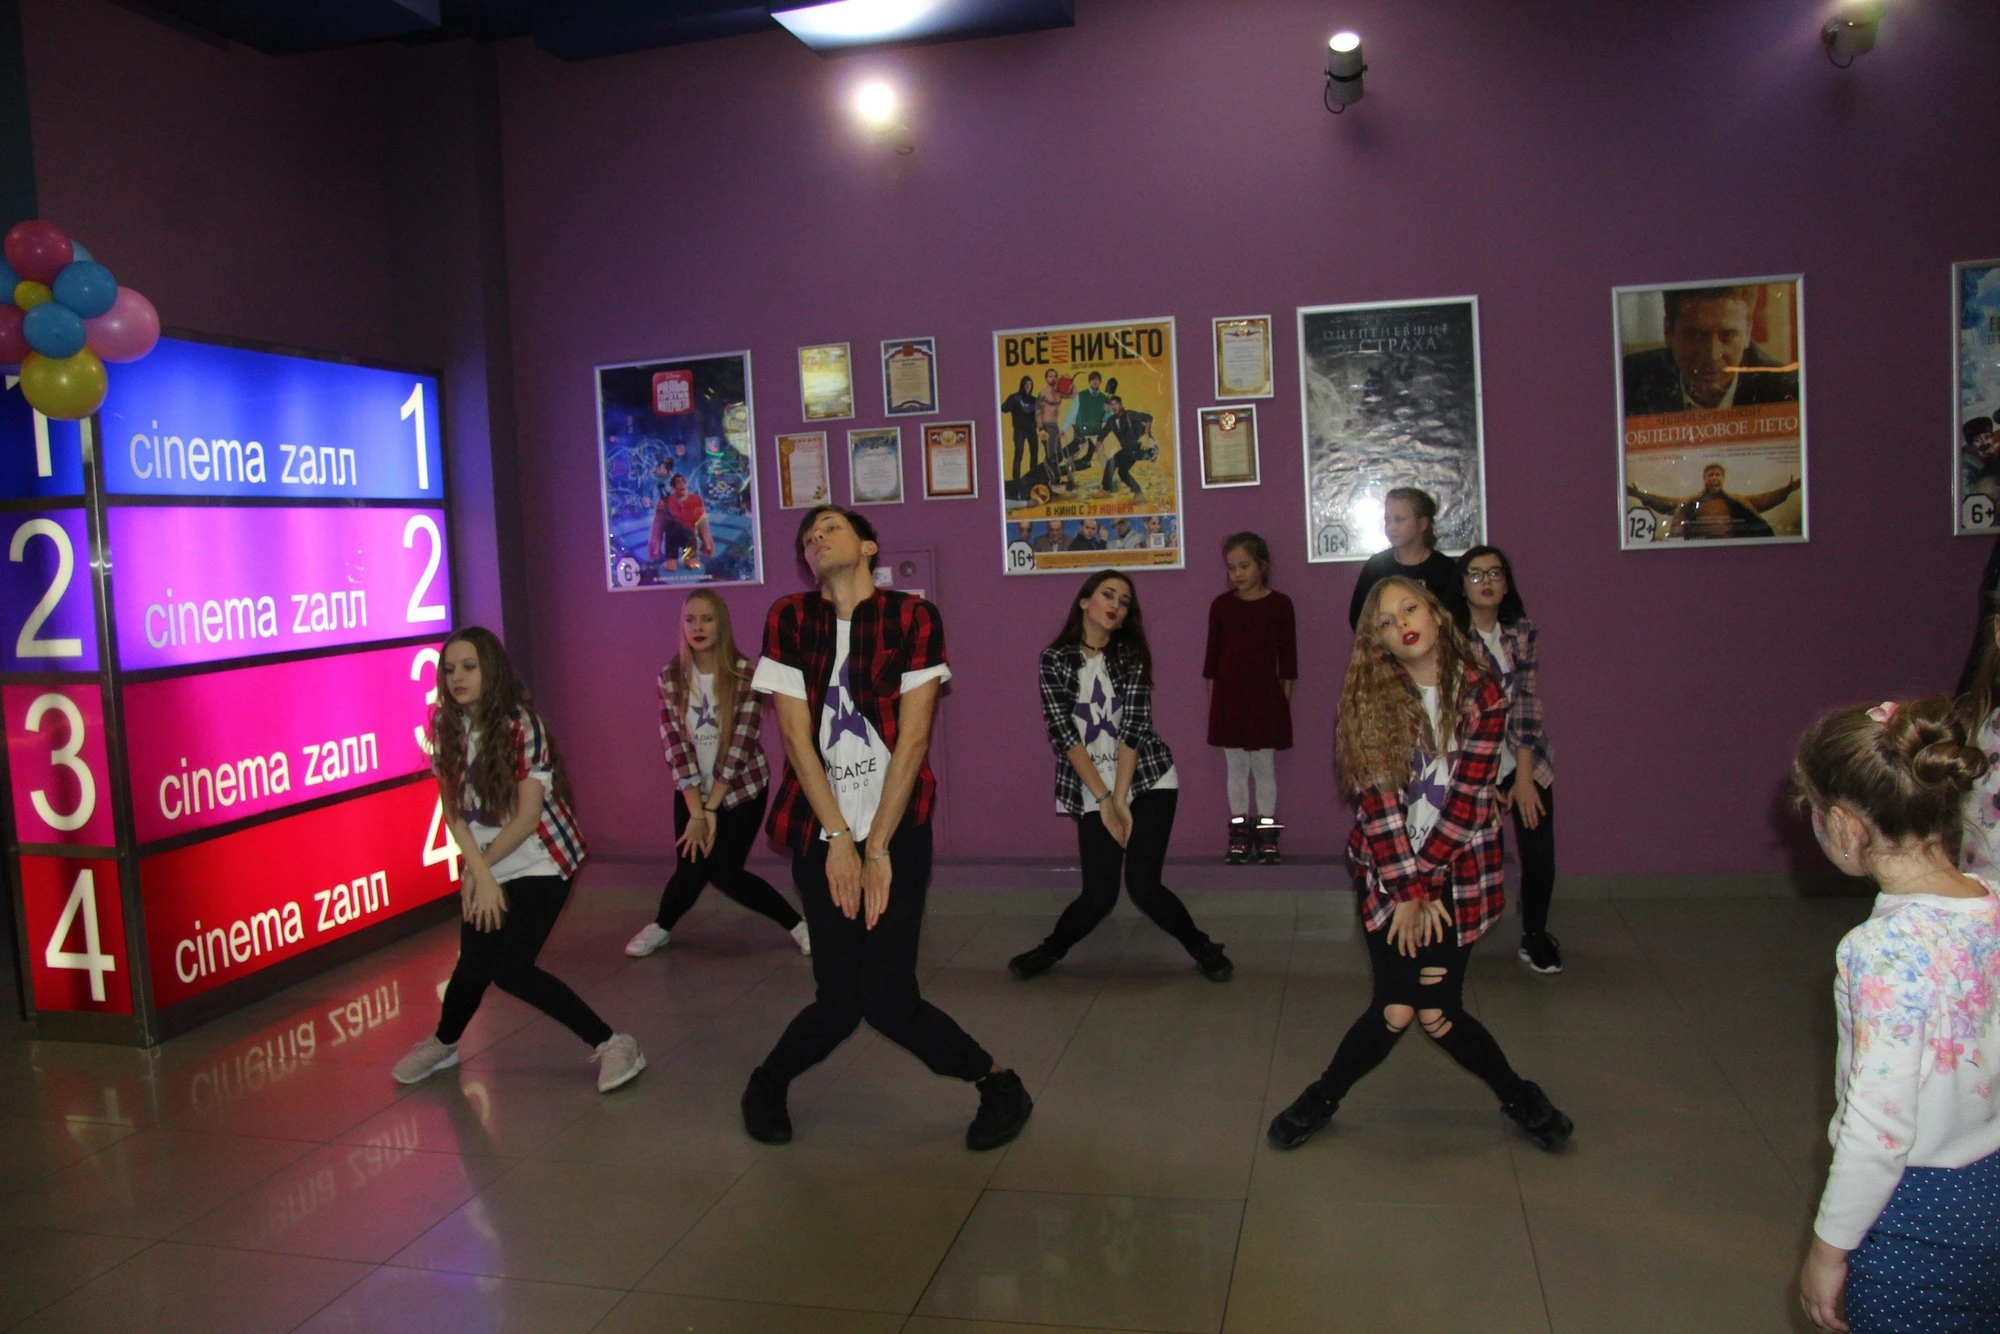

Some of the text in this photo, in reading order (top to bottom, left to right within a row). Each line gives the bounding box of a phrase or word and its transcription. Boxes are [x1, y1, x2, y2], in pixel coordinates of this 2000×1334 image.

[1005, 328, 1163, 366] ВСЁ ИЛИ НИЧЕГО
[1359, 337, 1437, 353] СТРАХА
[129, 420, 267, 485] cinema
[400, 382, 430, 490] 1
[1625, 416, 1798, 445] ОБЛЕПИХОВОЕ ЛЕТО
[1046, 505, 1051, 516] В
[1054, 504, 1076, 516] КИНО
[1079, 504, 1085, 515] С
[1630, 517, 1654, 538] 12+
[1971, 504, 1995, 524] 6+
[624, 564, 640, 581] 6+
[1012, 550, 1034, 568] 16+
[9, 518, 82, 659] 2
[144, 588, 279, 650] cinema
[403, 514, 446, 624] 2
[24, 693, 96, 831] 3
[159, 749, 291, 821] cinema
[175, 901, 304, 984] cinema
[423, 795, 463, 882] 4
[45, 869, 116, 1002] 4
